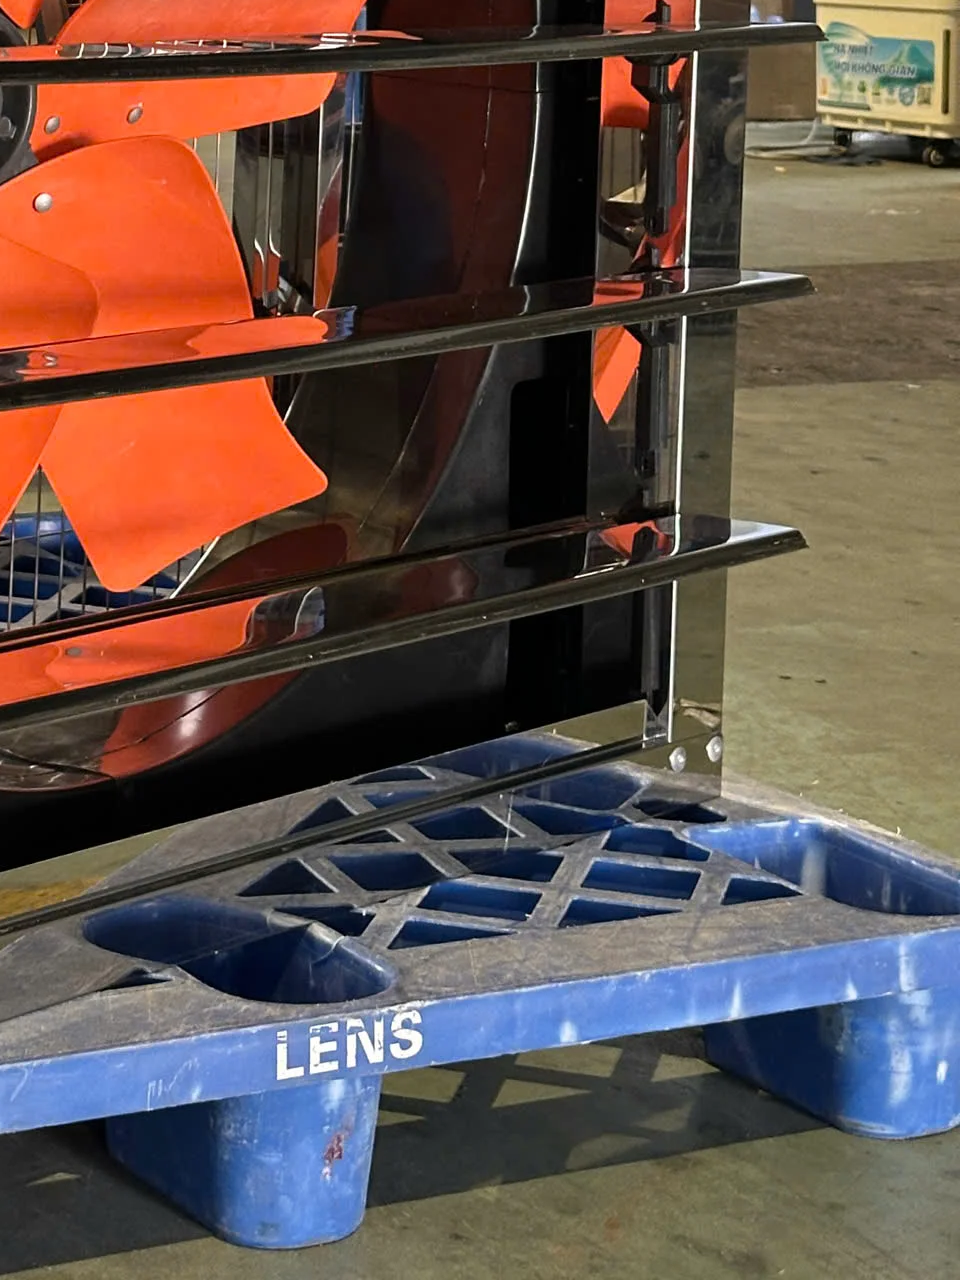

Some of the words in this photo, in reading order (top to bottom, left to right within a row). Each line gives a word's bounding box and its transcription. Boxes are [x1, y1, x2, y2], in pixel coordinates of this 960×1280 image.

[851, 62, 886, 73] KHÔNG
[888, 64, 916, 77] GIAN
[276, 1009, 423, 1081] LENS
